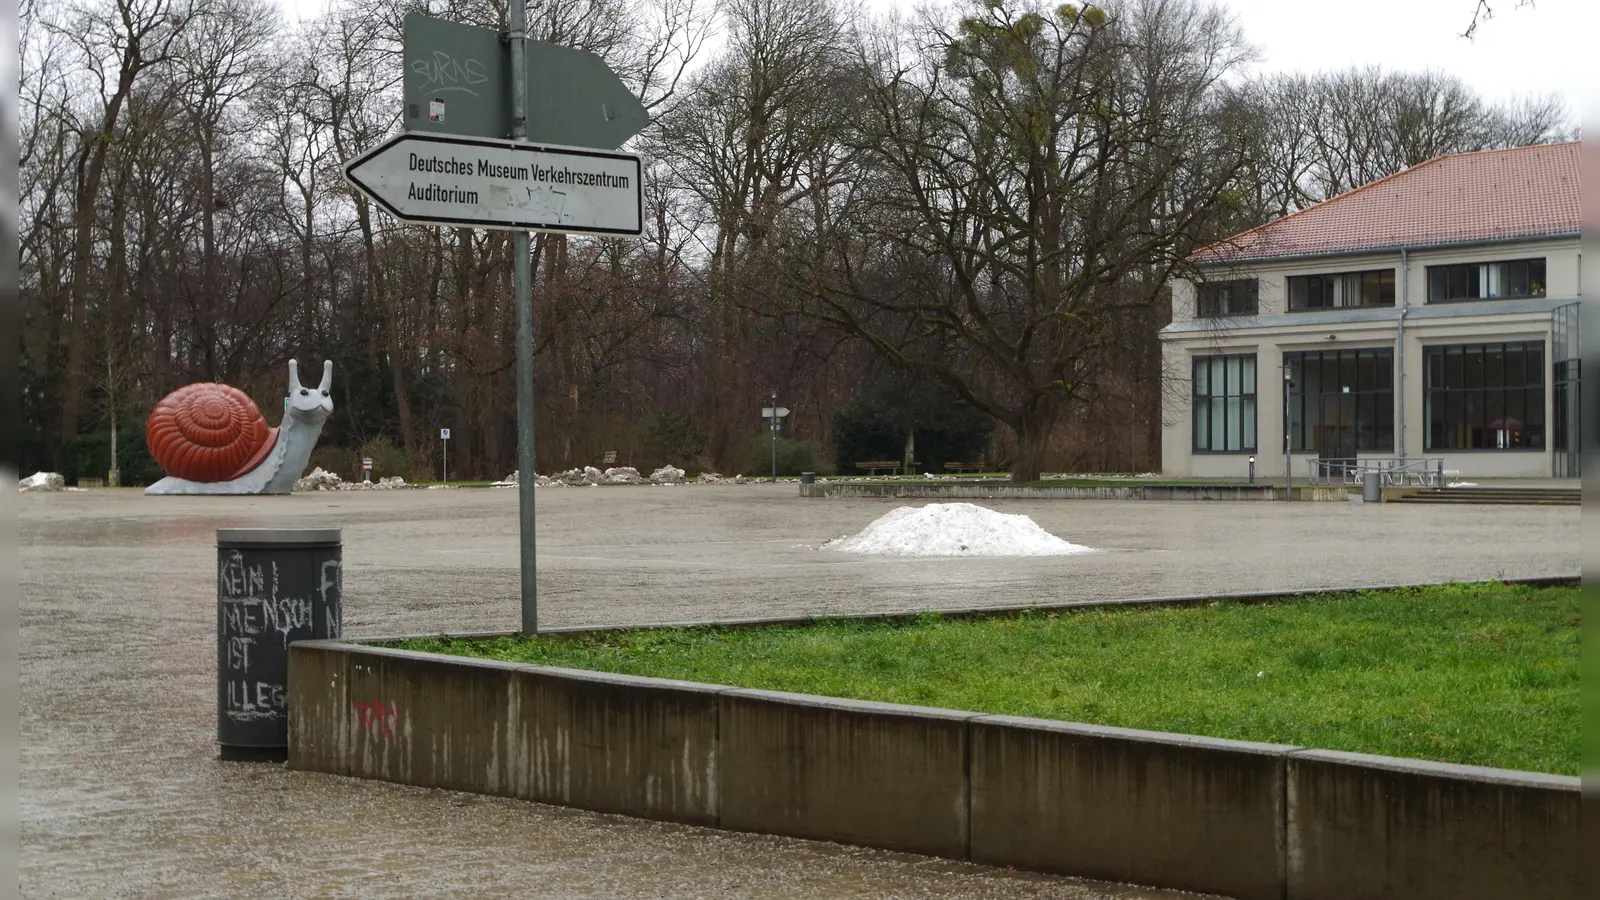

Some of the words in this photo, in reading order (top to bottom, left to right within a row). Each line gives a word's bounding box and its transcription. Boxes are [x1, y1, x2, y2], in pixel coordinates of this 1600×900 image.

[409, 152, 474, 176] Deutsches
[478, 159, 528, 181] Museum
[531, 164, 629, 189] Verkehrszentrum
[408, 182, 479, 205] Auditorium
[222, 598, 313, 636] MENSCH
[227, 636, 256, 674] IST
[227, 680, 287, 709] ILLEG
